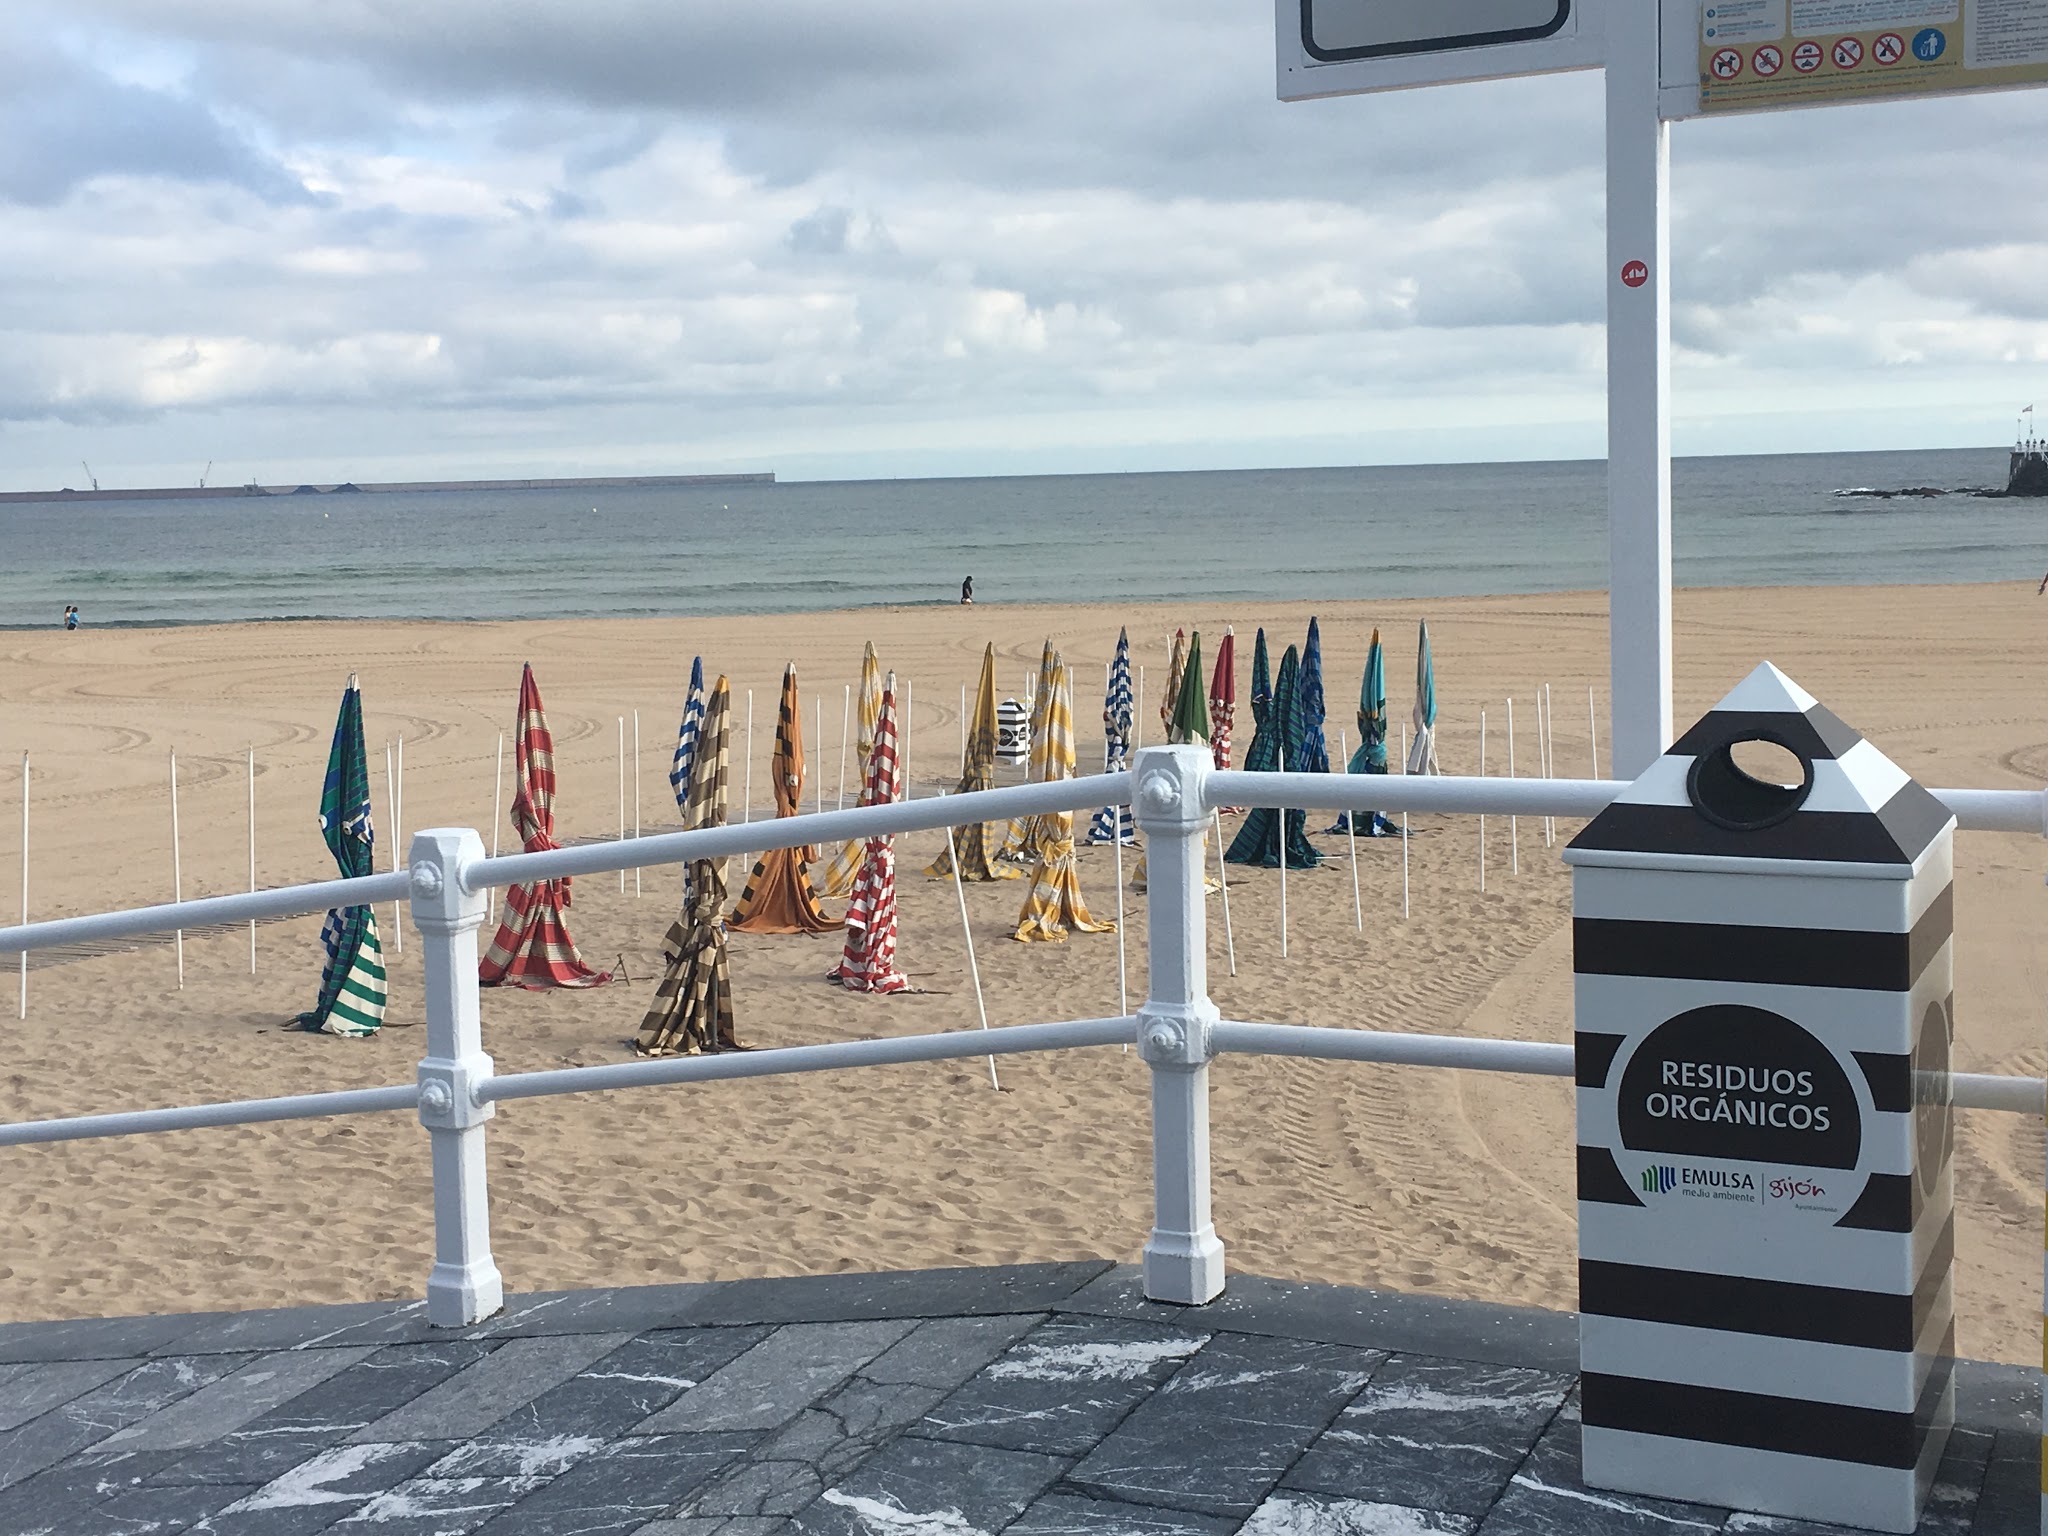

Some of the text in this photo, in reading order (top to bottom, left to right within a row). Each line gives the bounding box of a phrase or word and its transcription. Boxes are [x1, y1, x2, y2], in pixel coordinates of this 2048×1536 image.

[1661, 1060, 1814, 1097] RESIDUOS
[1645, 1091, 1831, 1132] ORGÁNICOS
[1682, 1167, 1755, 1190] EMULSA
[1768, 1176, 1827, 1200] gijón
[1713, 1190, 1756, 1203] ambiente
